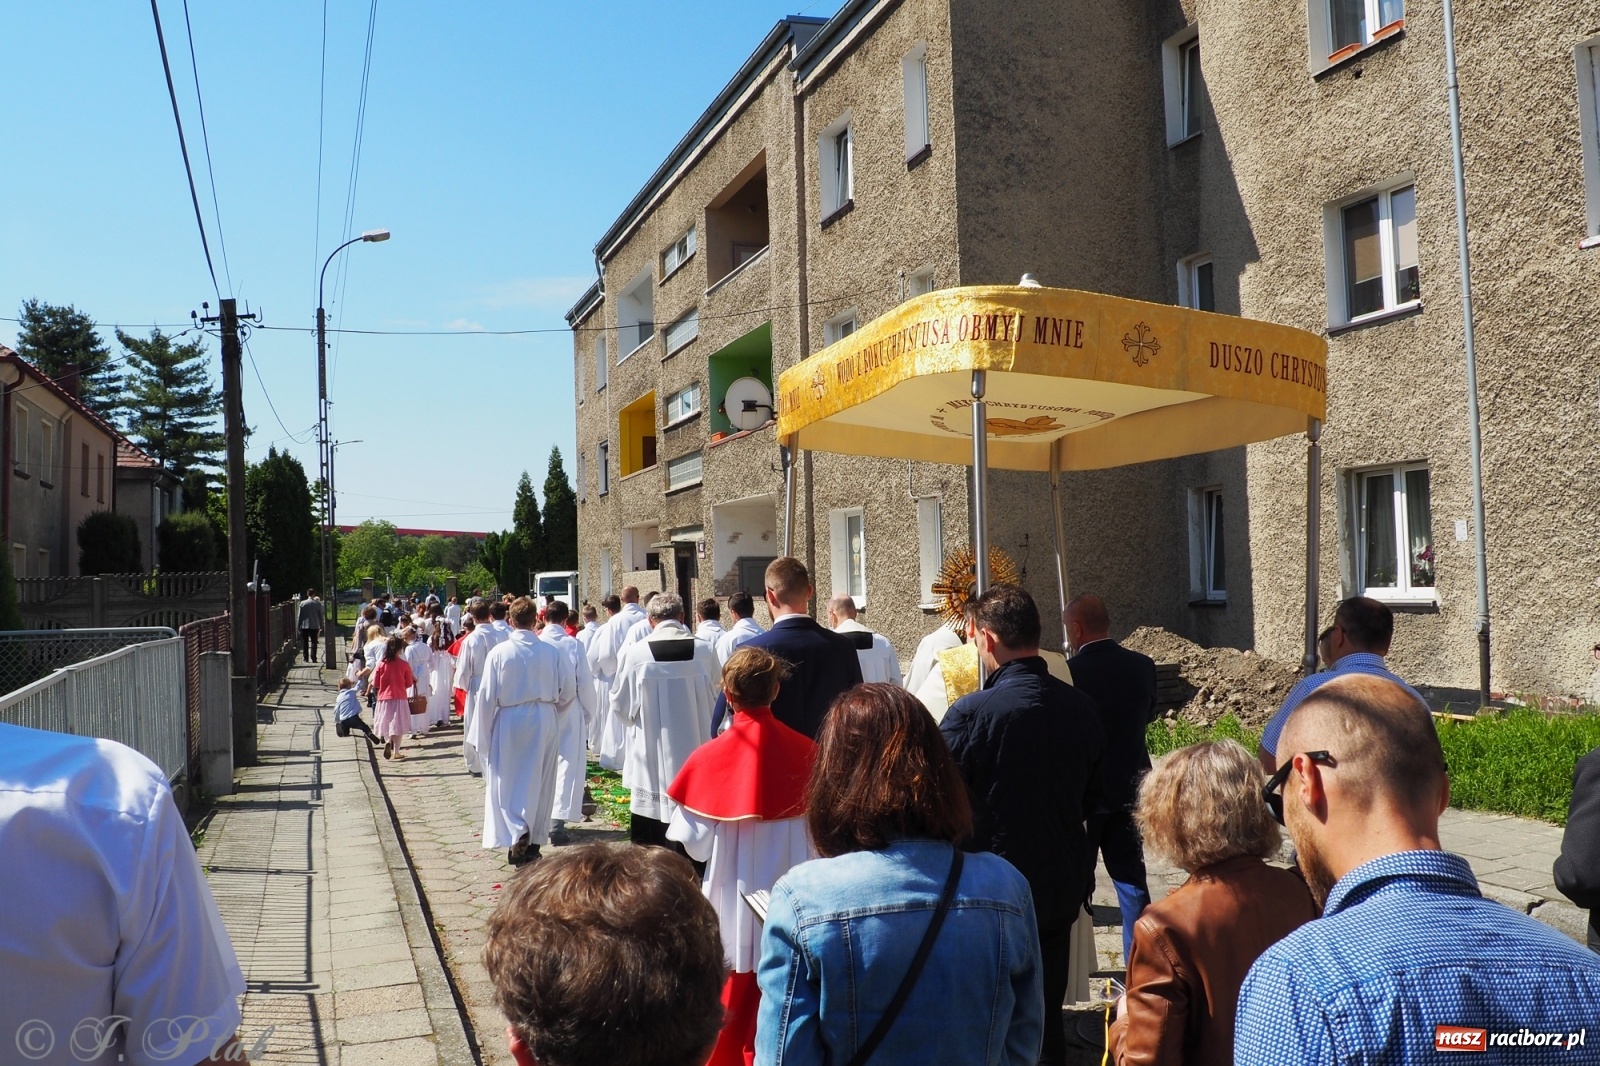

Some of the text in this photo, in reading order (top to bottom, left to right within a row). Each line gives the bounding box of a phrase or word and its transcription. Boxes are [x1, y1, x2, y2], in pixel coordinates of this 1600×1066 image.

[863, 340, 884, 374] BOKU
[886, 318, 950, 363] CHRYSTUSA
[958, 314, 1025, 343] OBMYJ
[1033, 316, 1084, 349] MNIE
[1209, 341, 1263, 376] DUSZO
